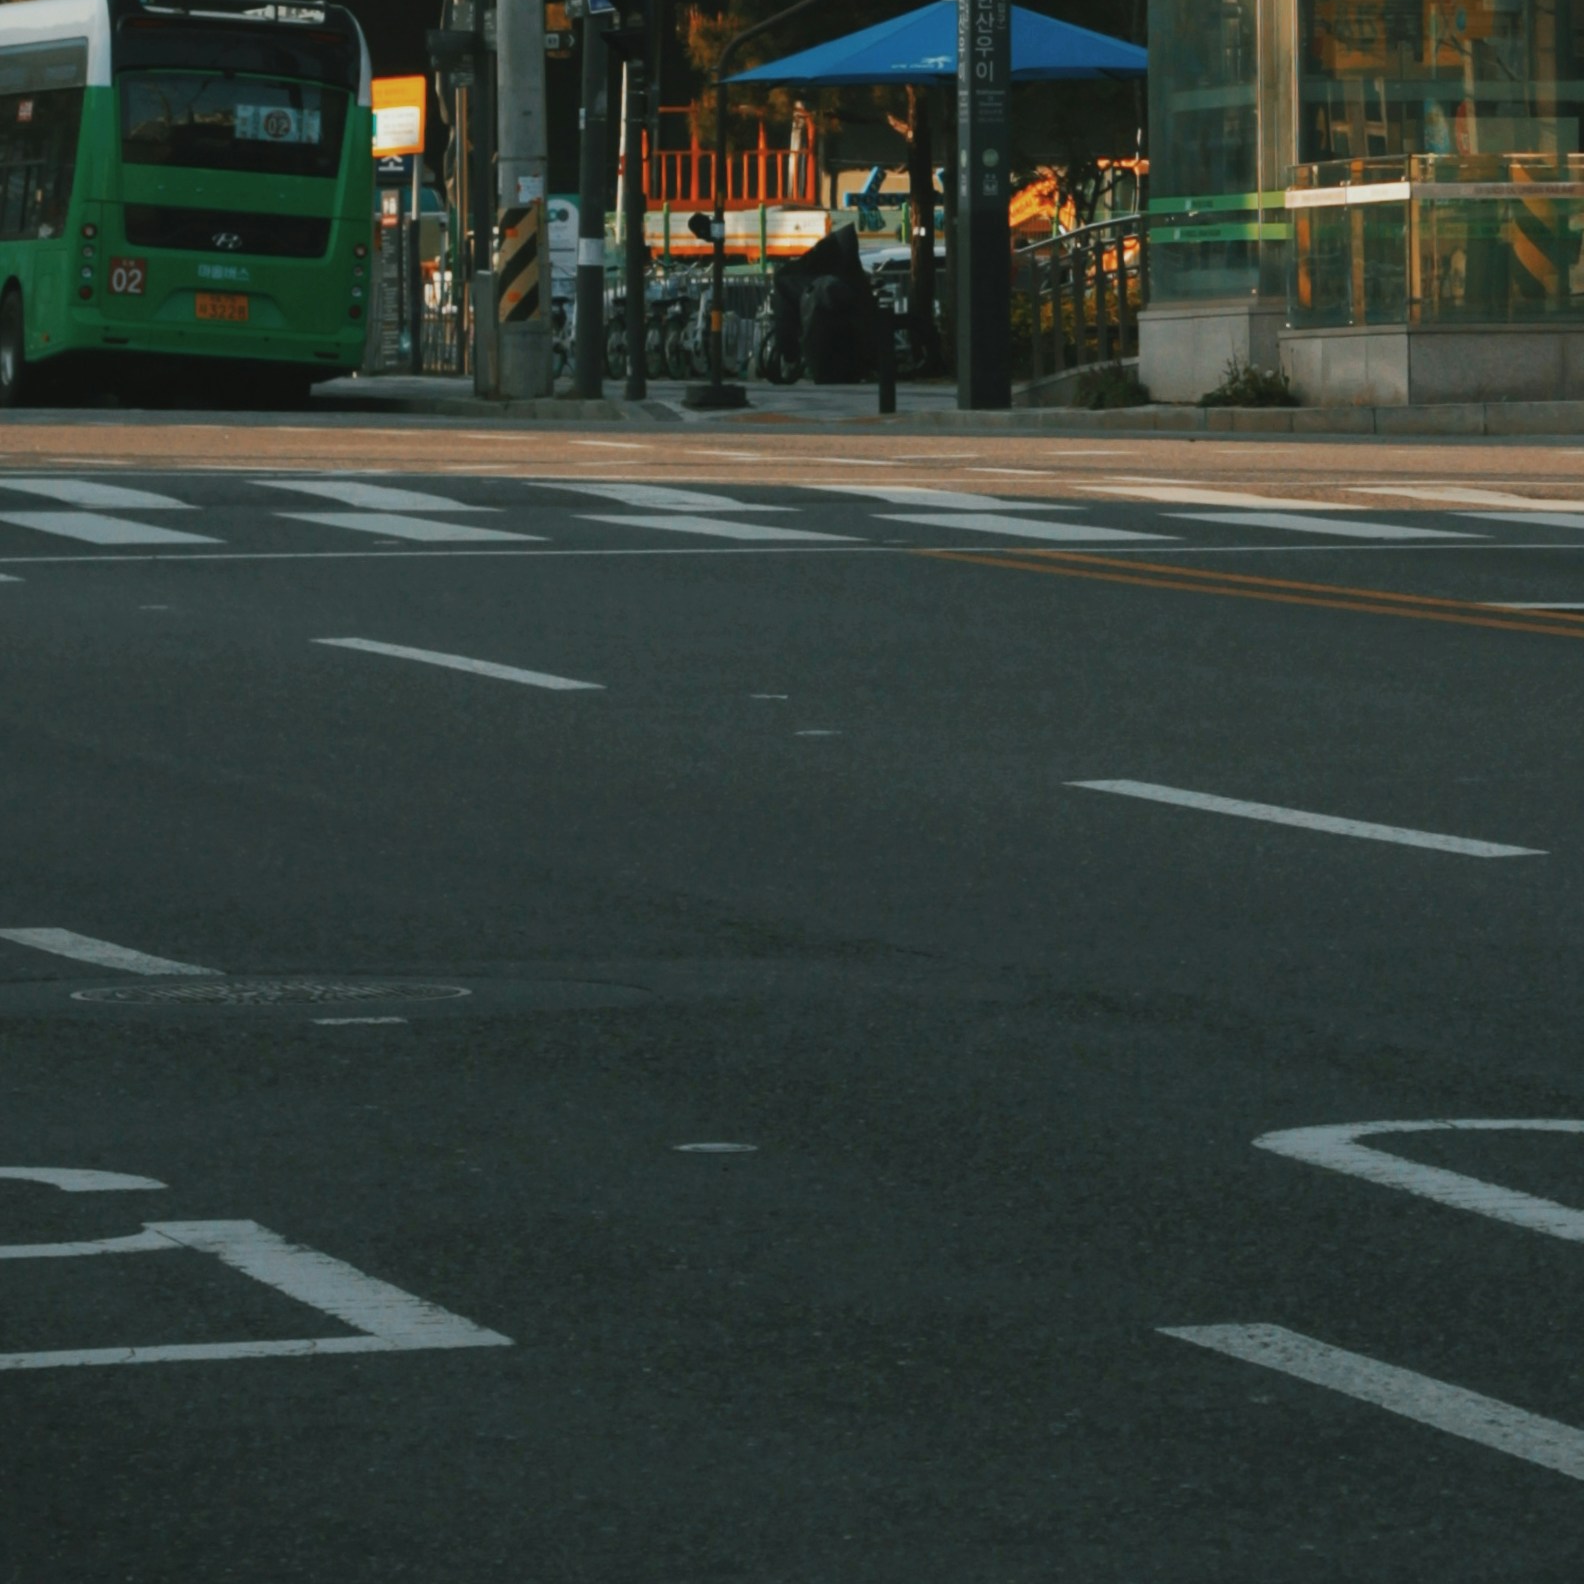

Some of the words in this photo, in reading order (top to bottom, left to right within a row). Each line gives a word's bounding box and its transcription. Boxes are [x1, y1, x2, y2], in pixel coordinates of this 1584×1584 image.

[267, 117, 289, 135] 02
[112, 267, 142, 293] 02
[197, 264, 250, 282] 마을버스
